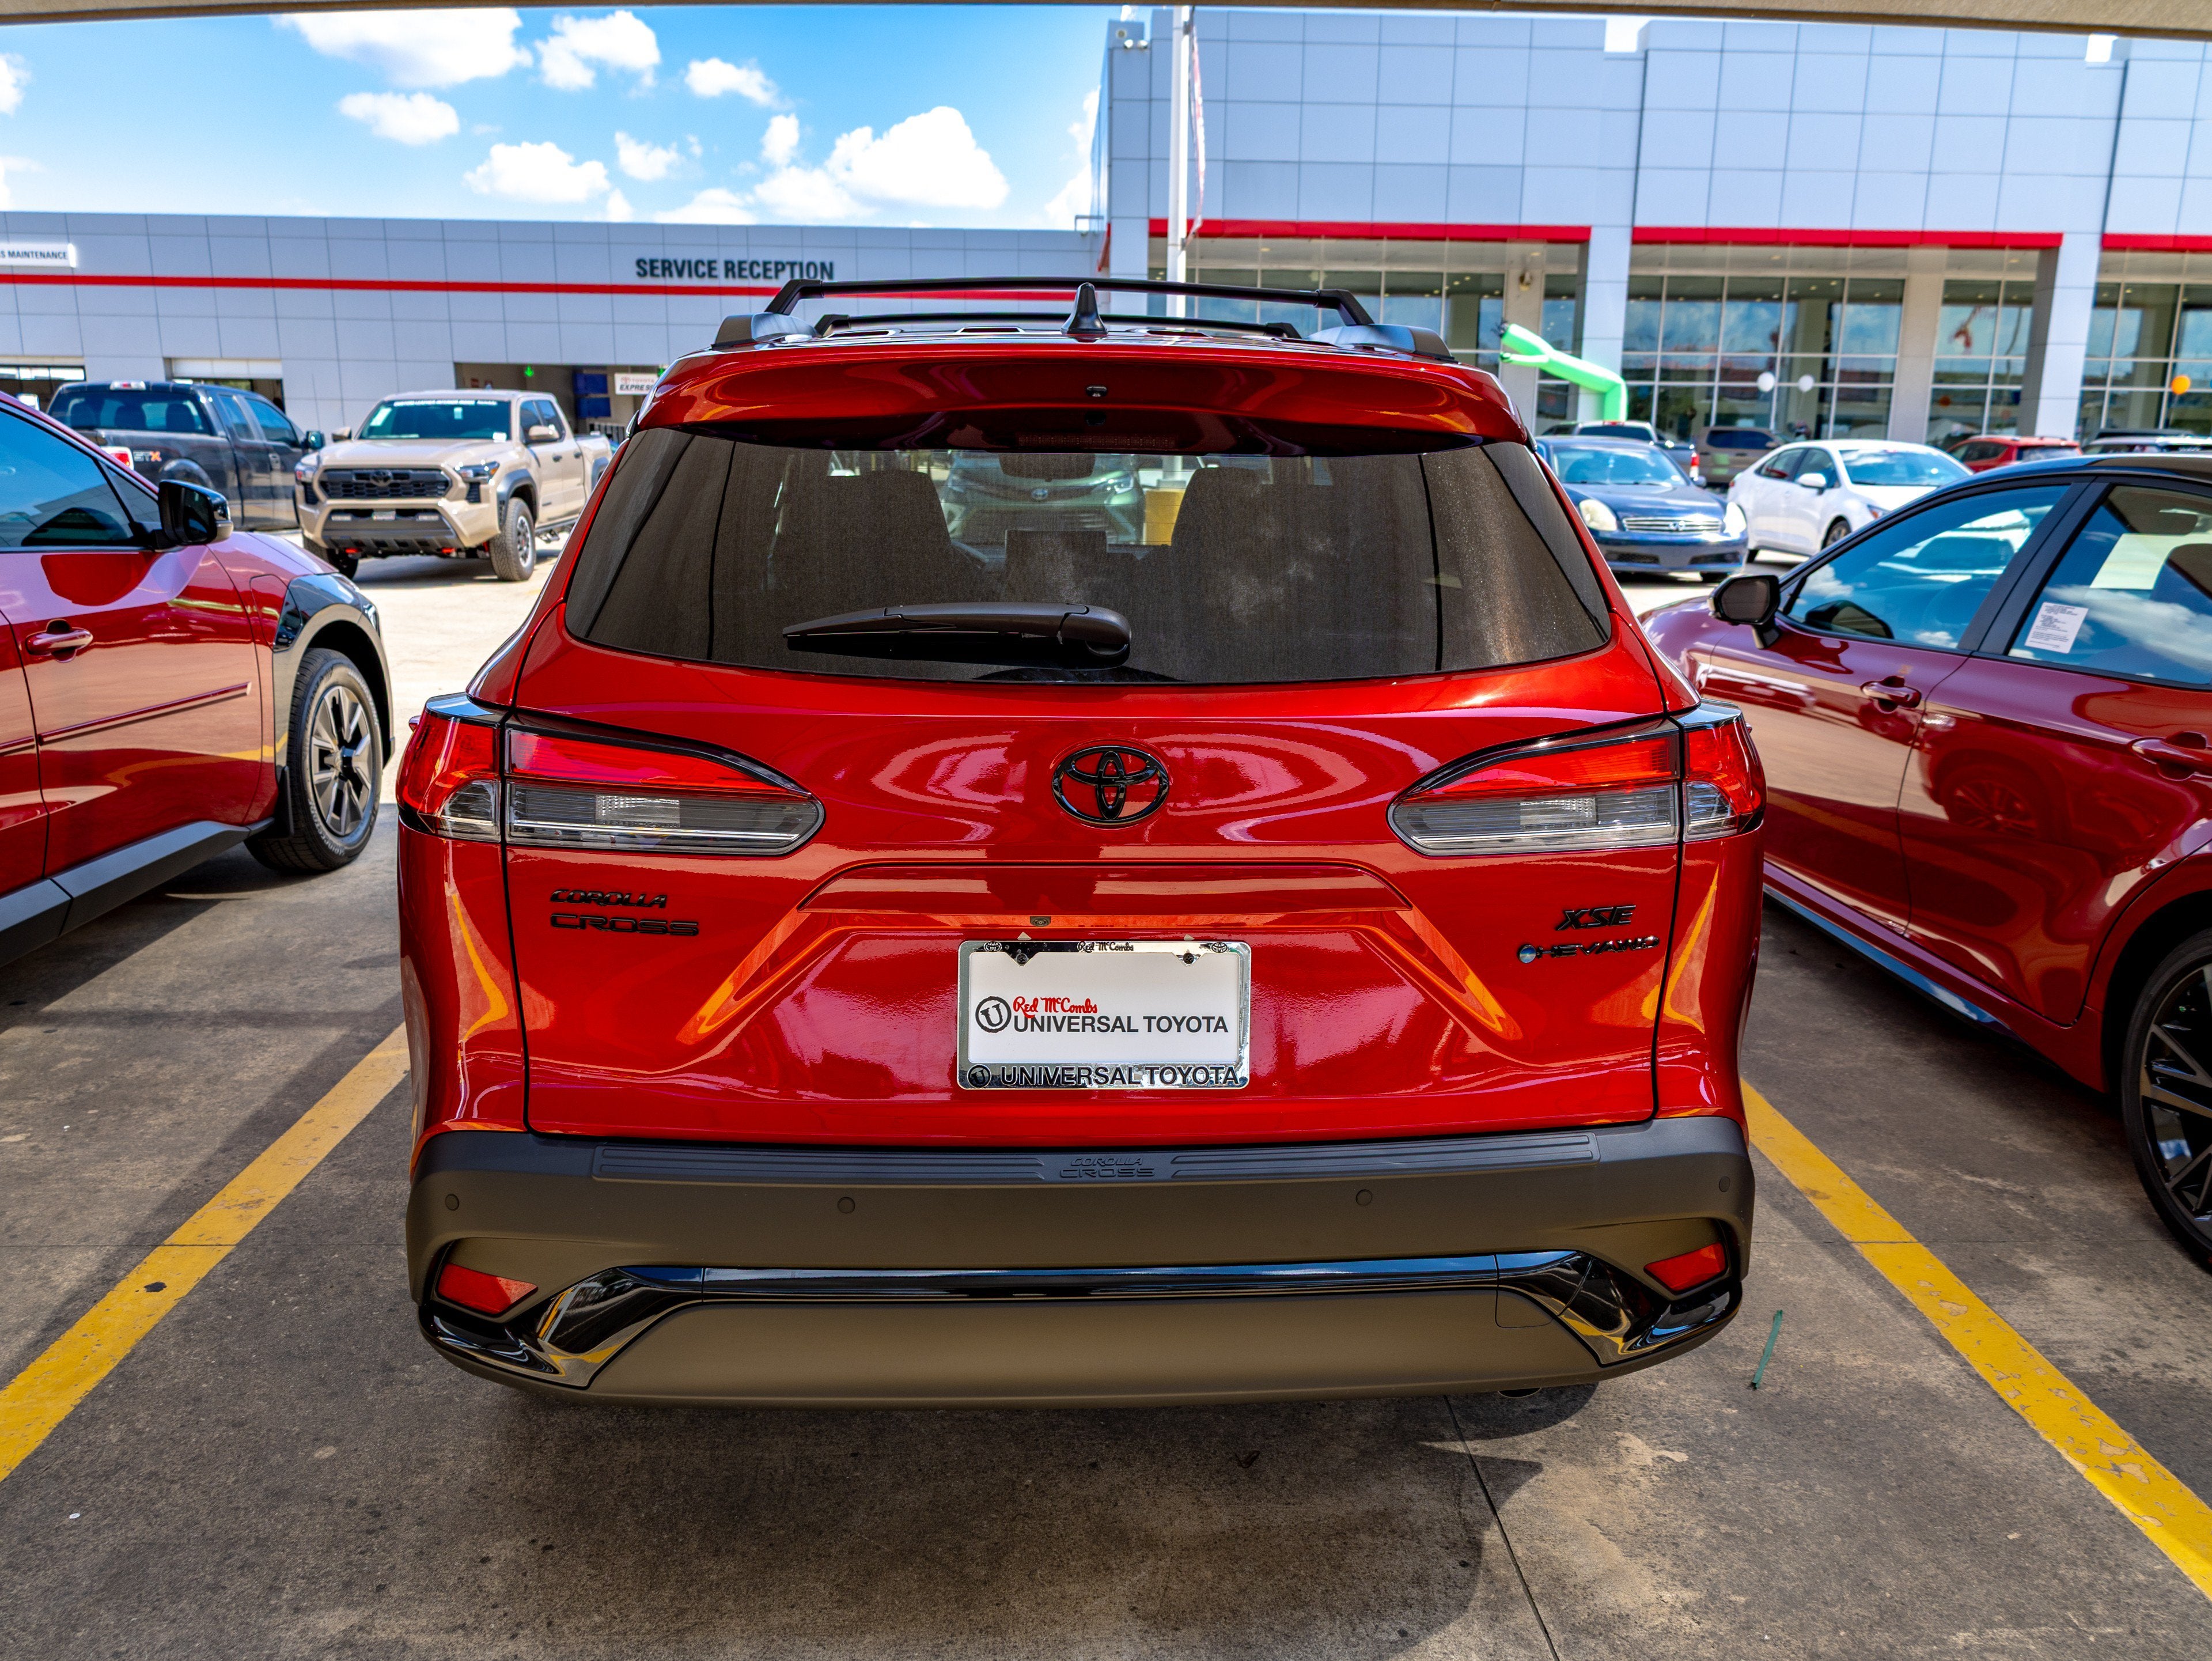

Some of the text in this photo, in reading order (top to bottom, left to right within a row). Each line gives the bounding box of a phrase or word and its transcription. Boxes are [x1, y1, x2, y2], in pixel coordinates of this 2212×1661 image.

[0, 250, 67, 259] S MAINTENANCE
[635, 258, 834, 280] SERVICE RECEPTION
[550, 889, 668, 909] COROLLA
[550, 913, 699, 936] CROSS
[1554, 905, 1636, 931] XSE
[1077, 941, 1134, 953] Red McCombs
[1013, 996, 1097, 1018] Red McCombs
[1014, 1015, 1229, 1032] UNIVERSAL TOYOTA
[1001, 1066, 1240, 1085] UNIVERSAL TOYOTA
[1071, 1157, 1143, 1167] COROLLA
[1060, 1168, 1154, 1178] CROSS
